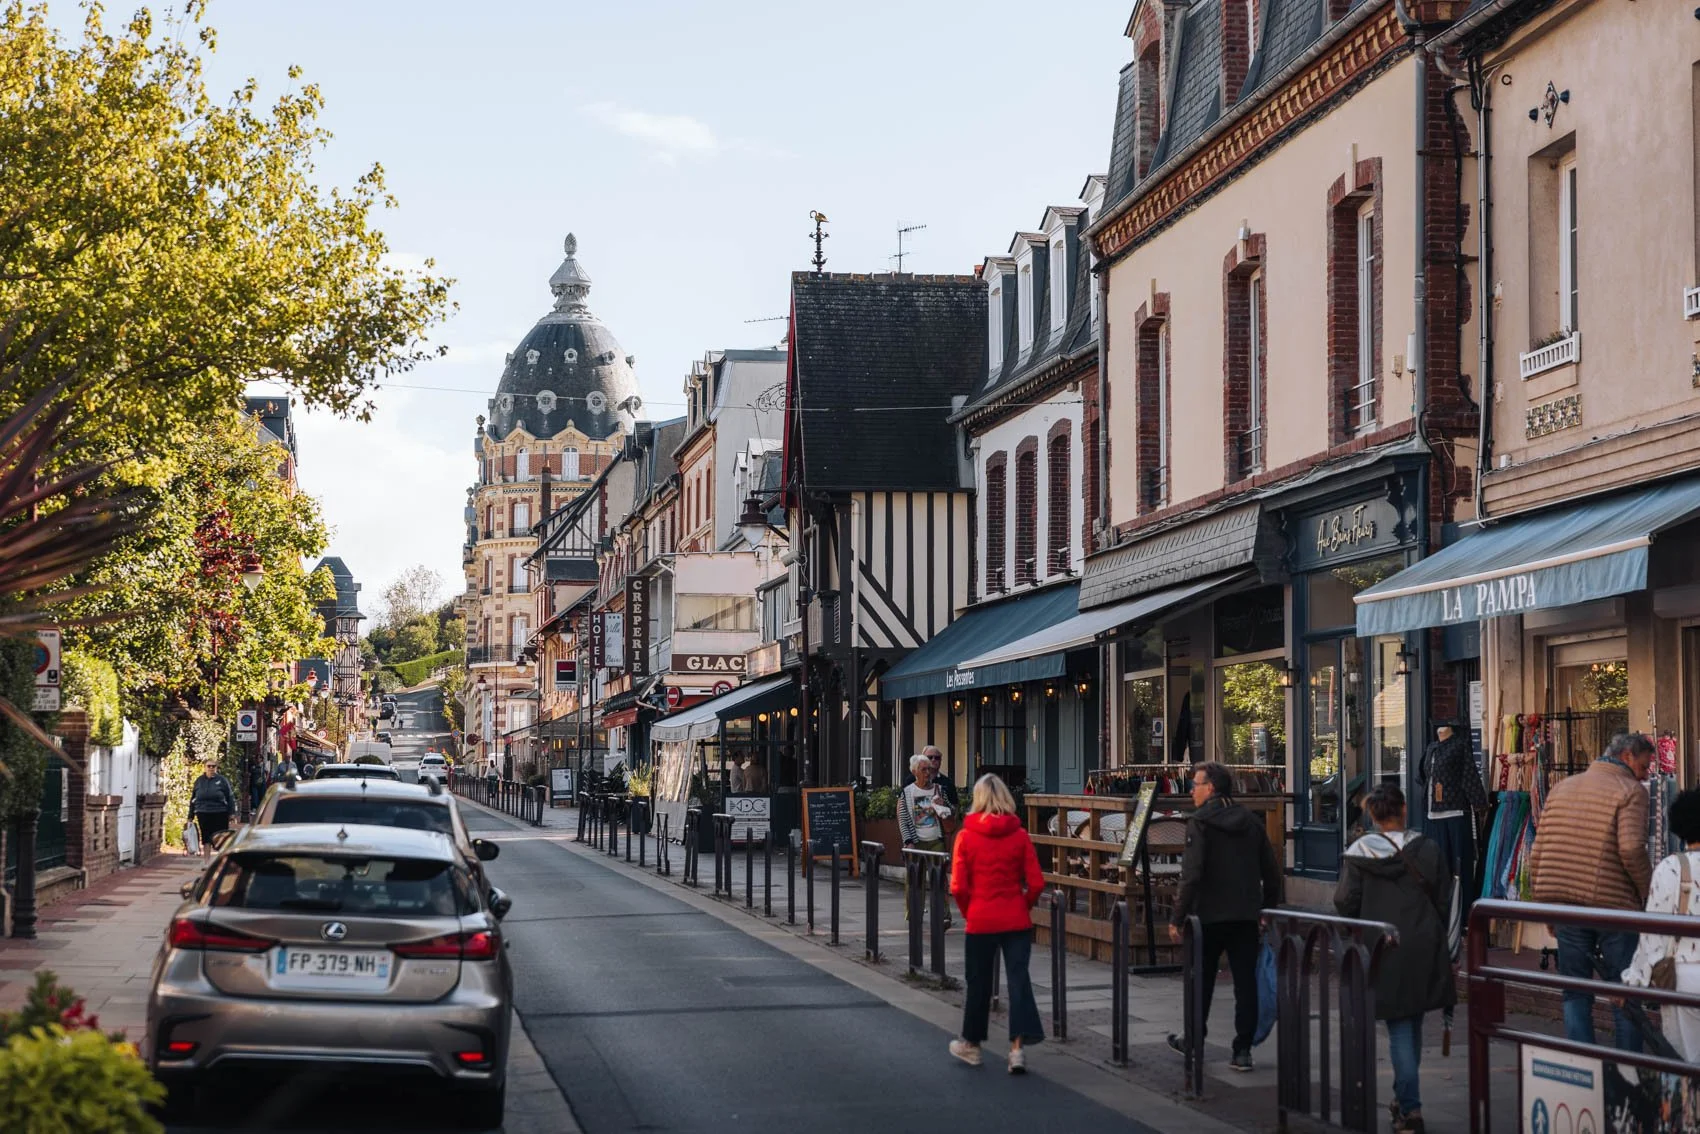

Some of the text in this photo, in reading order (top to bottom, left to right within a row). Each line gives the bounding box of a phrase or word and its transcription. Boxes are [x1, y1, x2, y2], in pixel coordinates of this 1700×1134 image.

[1442, 573, 1536, 621] LA PAMPA
[593, 614, 601, 666] HOTEL
